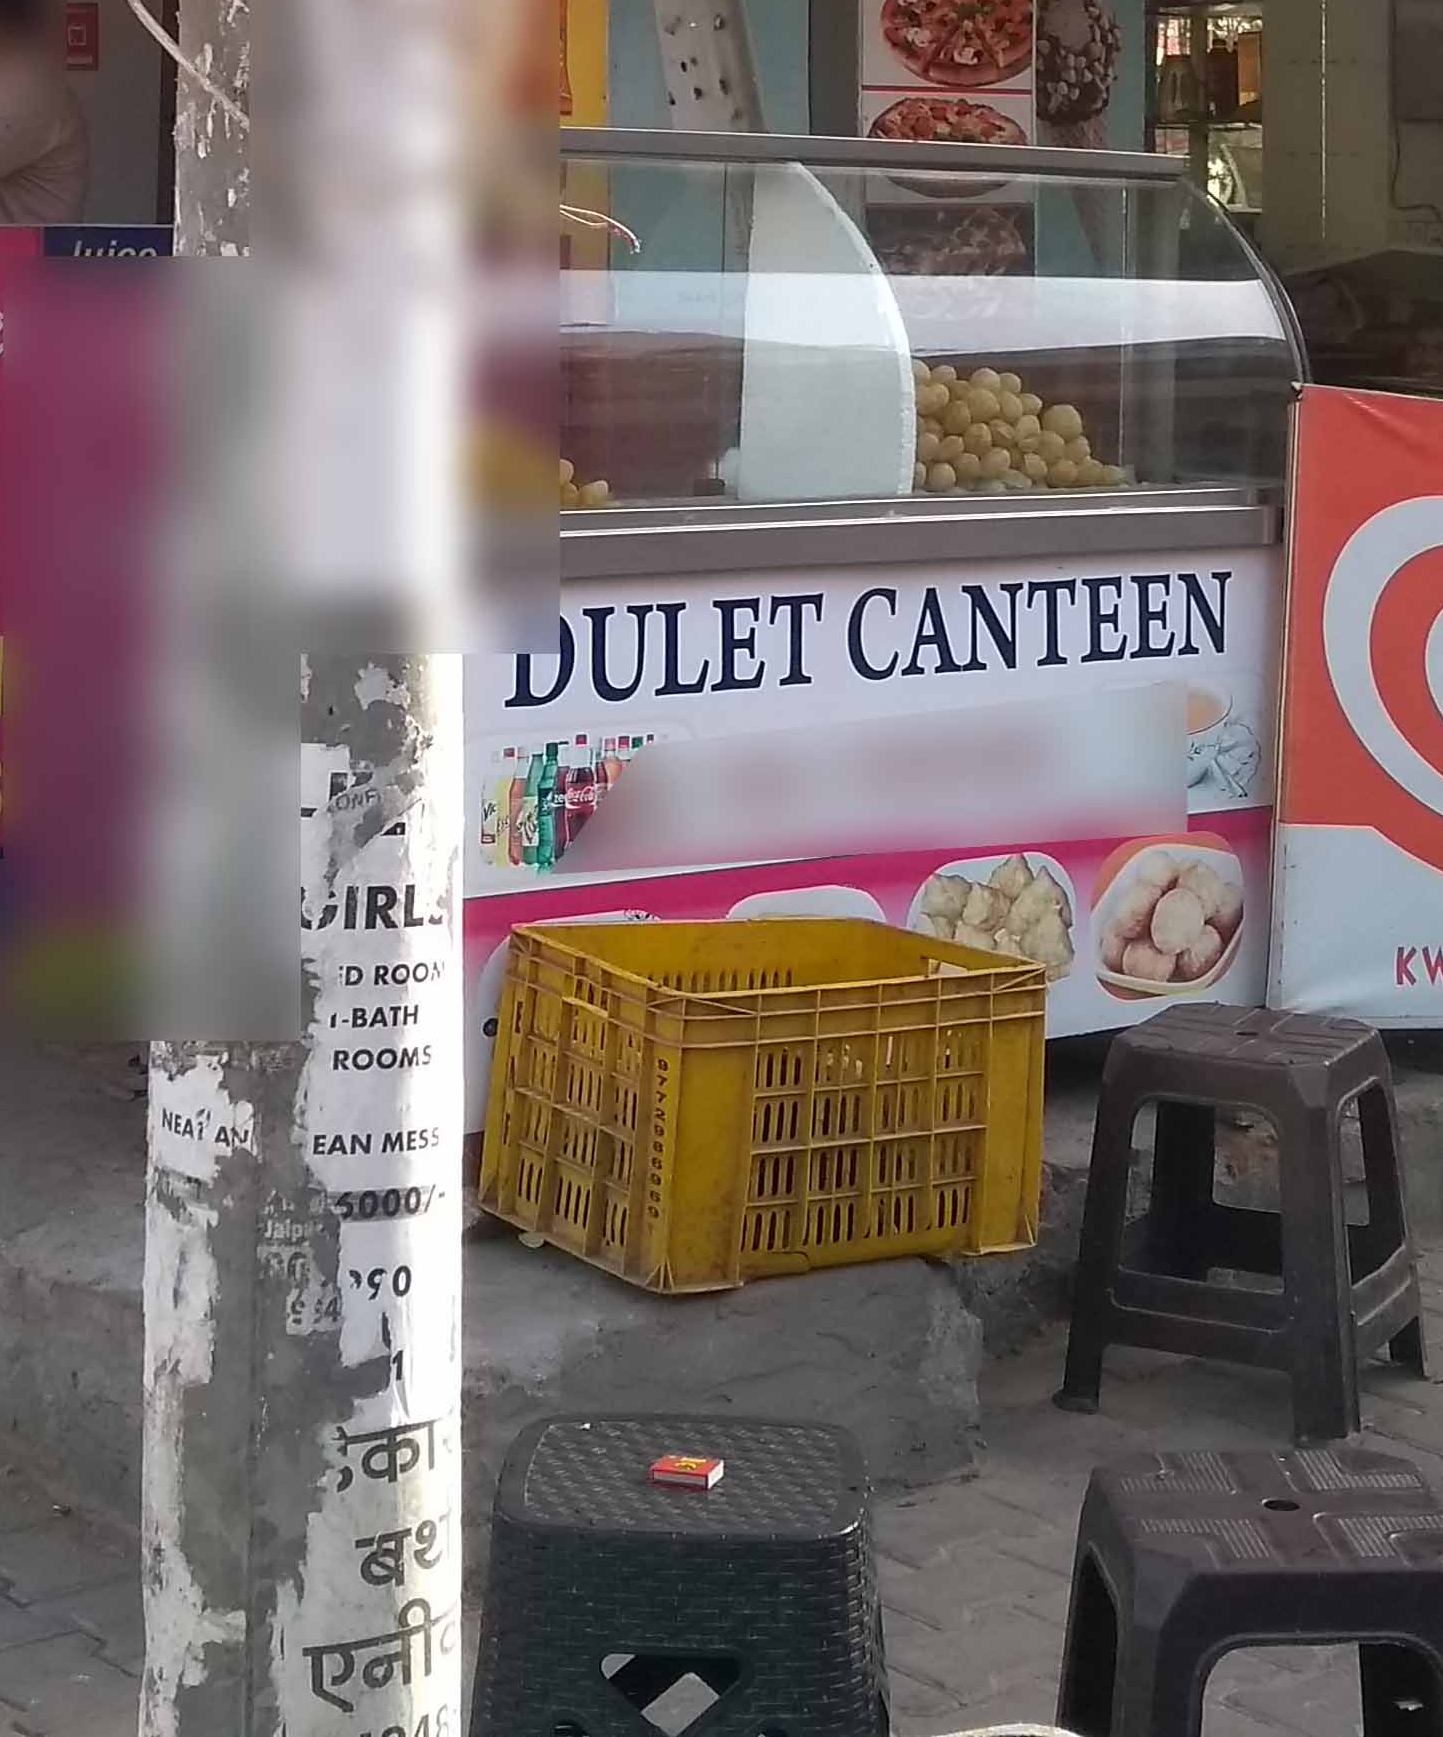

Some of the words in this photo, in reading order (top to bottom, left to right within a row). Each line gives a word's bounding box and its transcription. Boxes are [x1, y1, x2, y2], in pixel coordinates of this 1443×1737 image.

[846, 571, 1234, 682] CANTEEN
[332, 1046, 433, 1072] ROOMS
[312, 1134, 373, 1156] EAN
